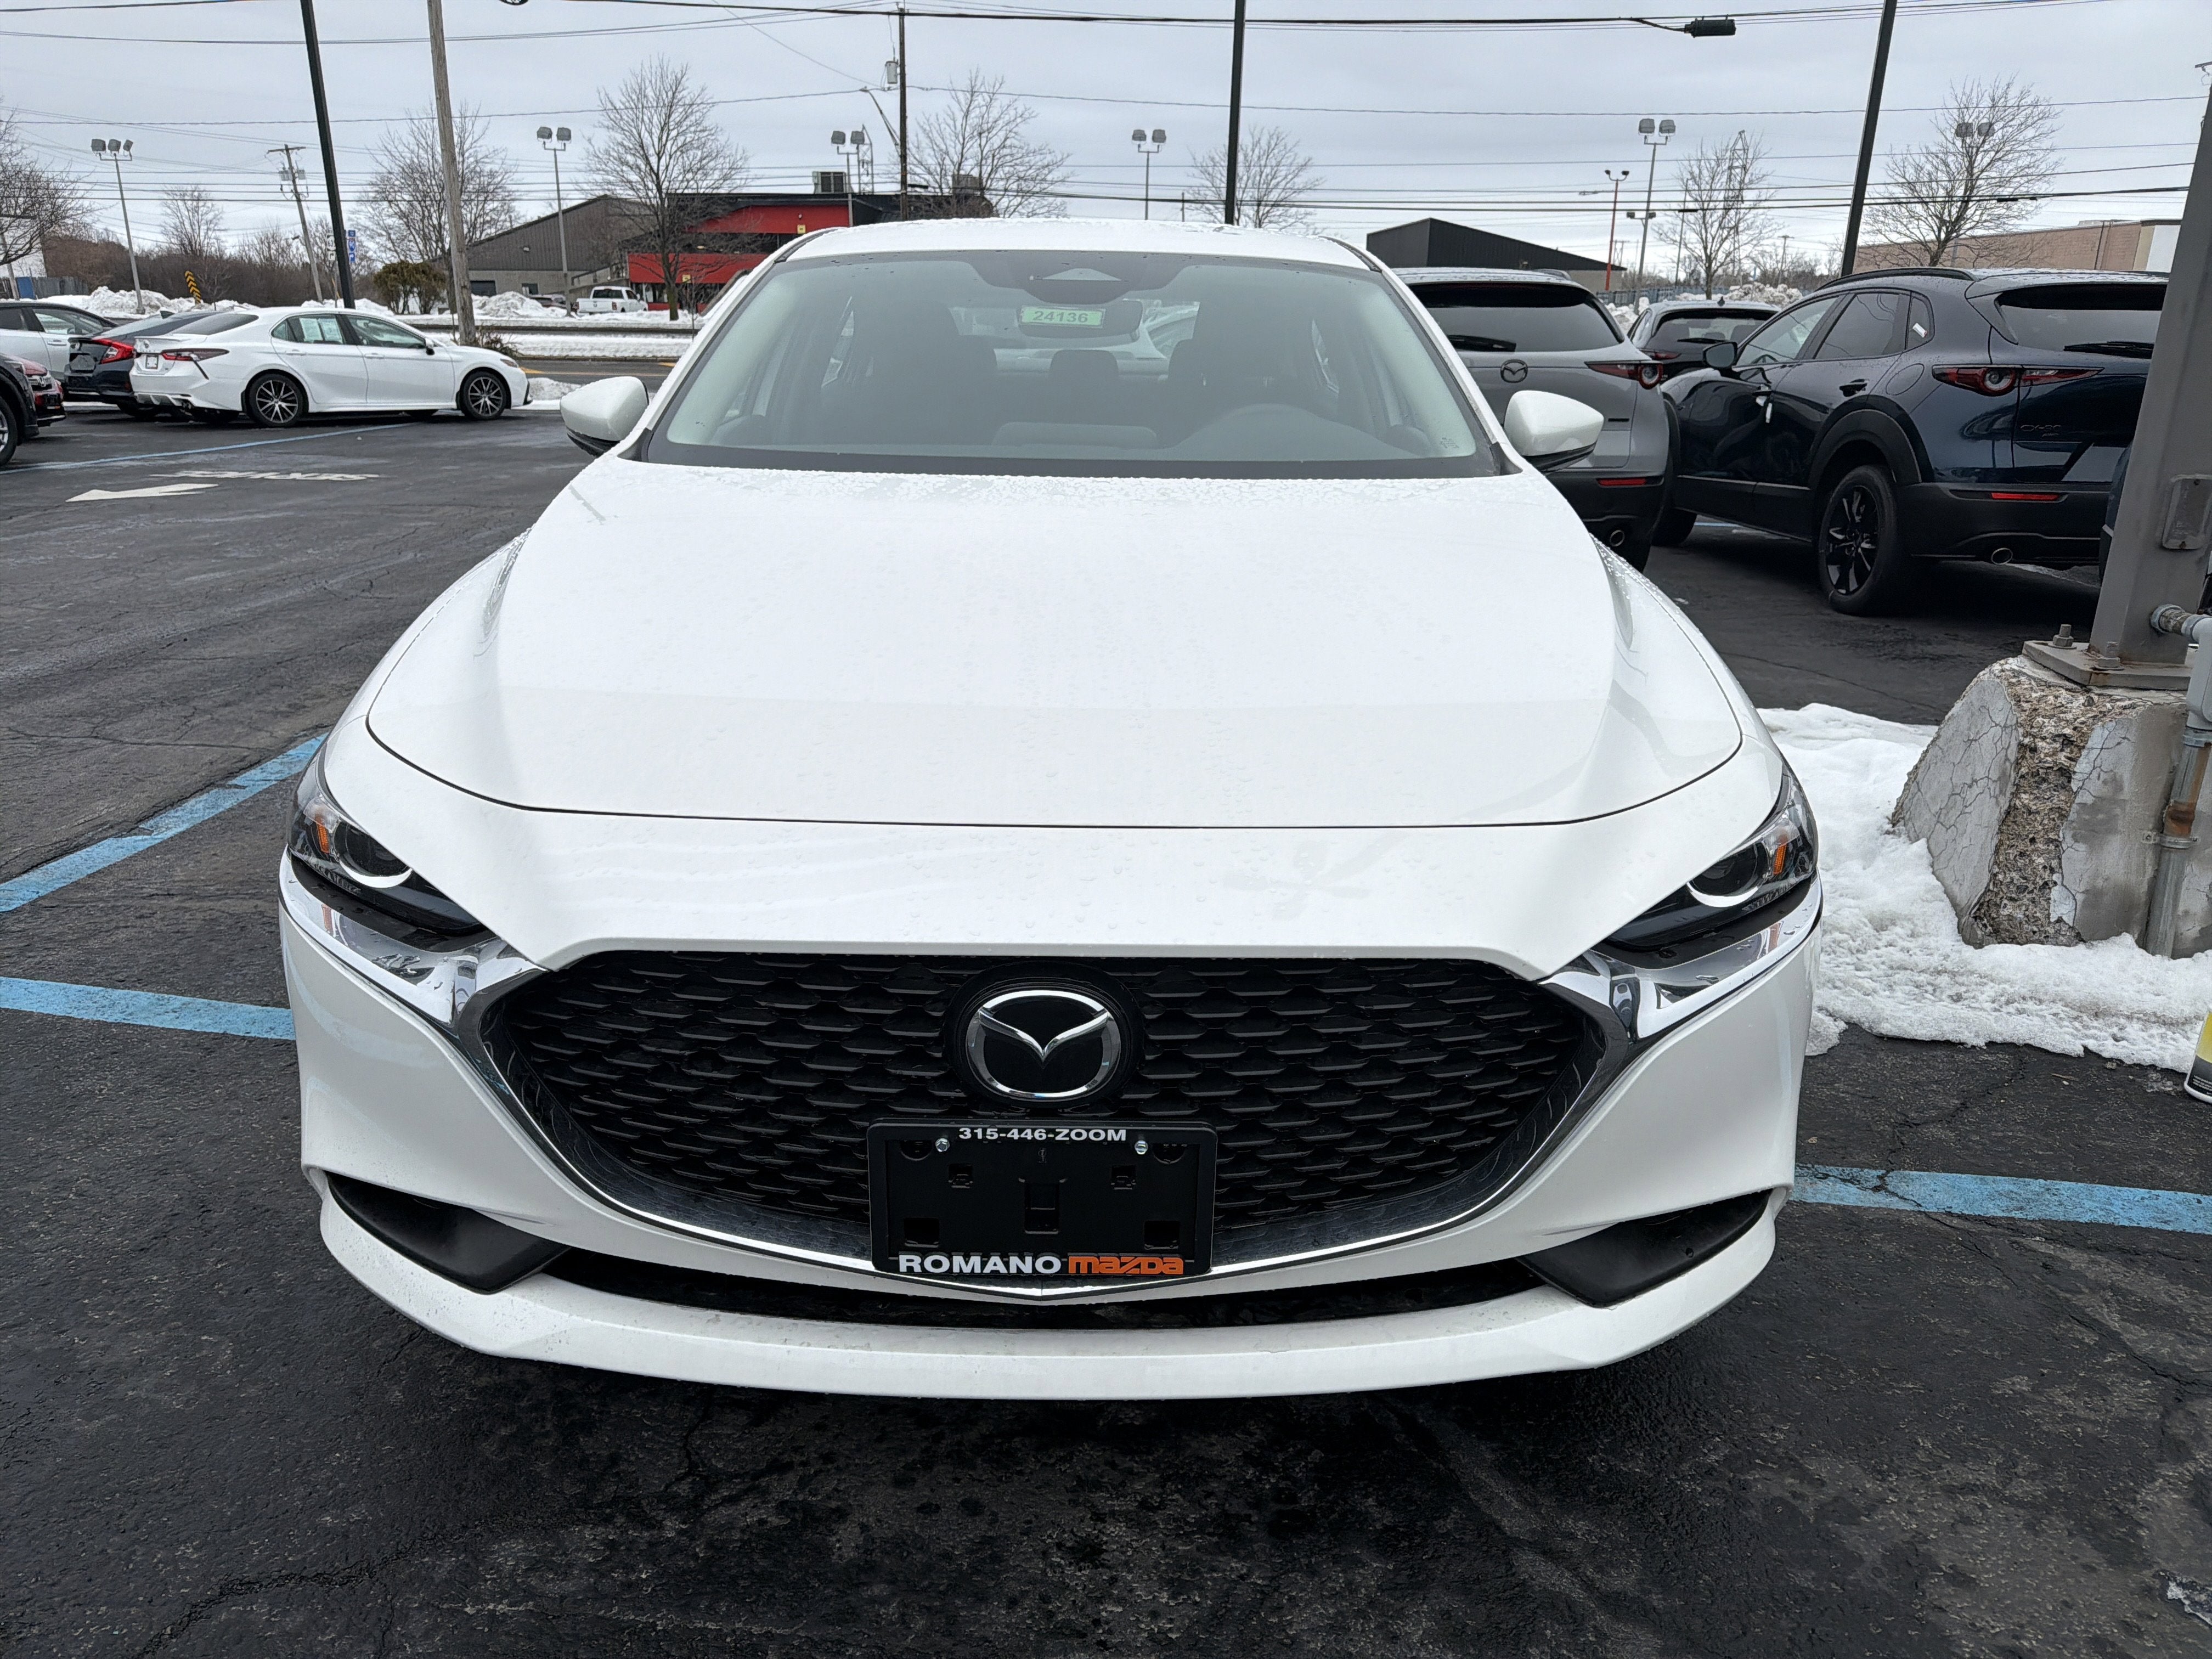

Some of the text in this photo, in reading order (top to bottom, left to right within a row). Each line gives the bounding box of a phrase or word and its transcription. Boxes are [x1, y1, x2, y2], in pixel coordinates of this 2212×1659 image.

[1033, 311, 1088, 323] 24136
[959, 1128, 1126, 1141] 315-446-ZOOM
[899, 1255, 1183, 1274] ROMANO mazda
